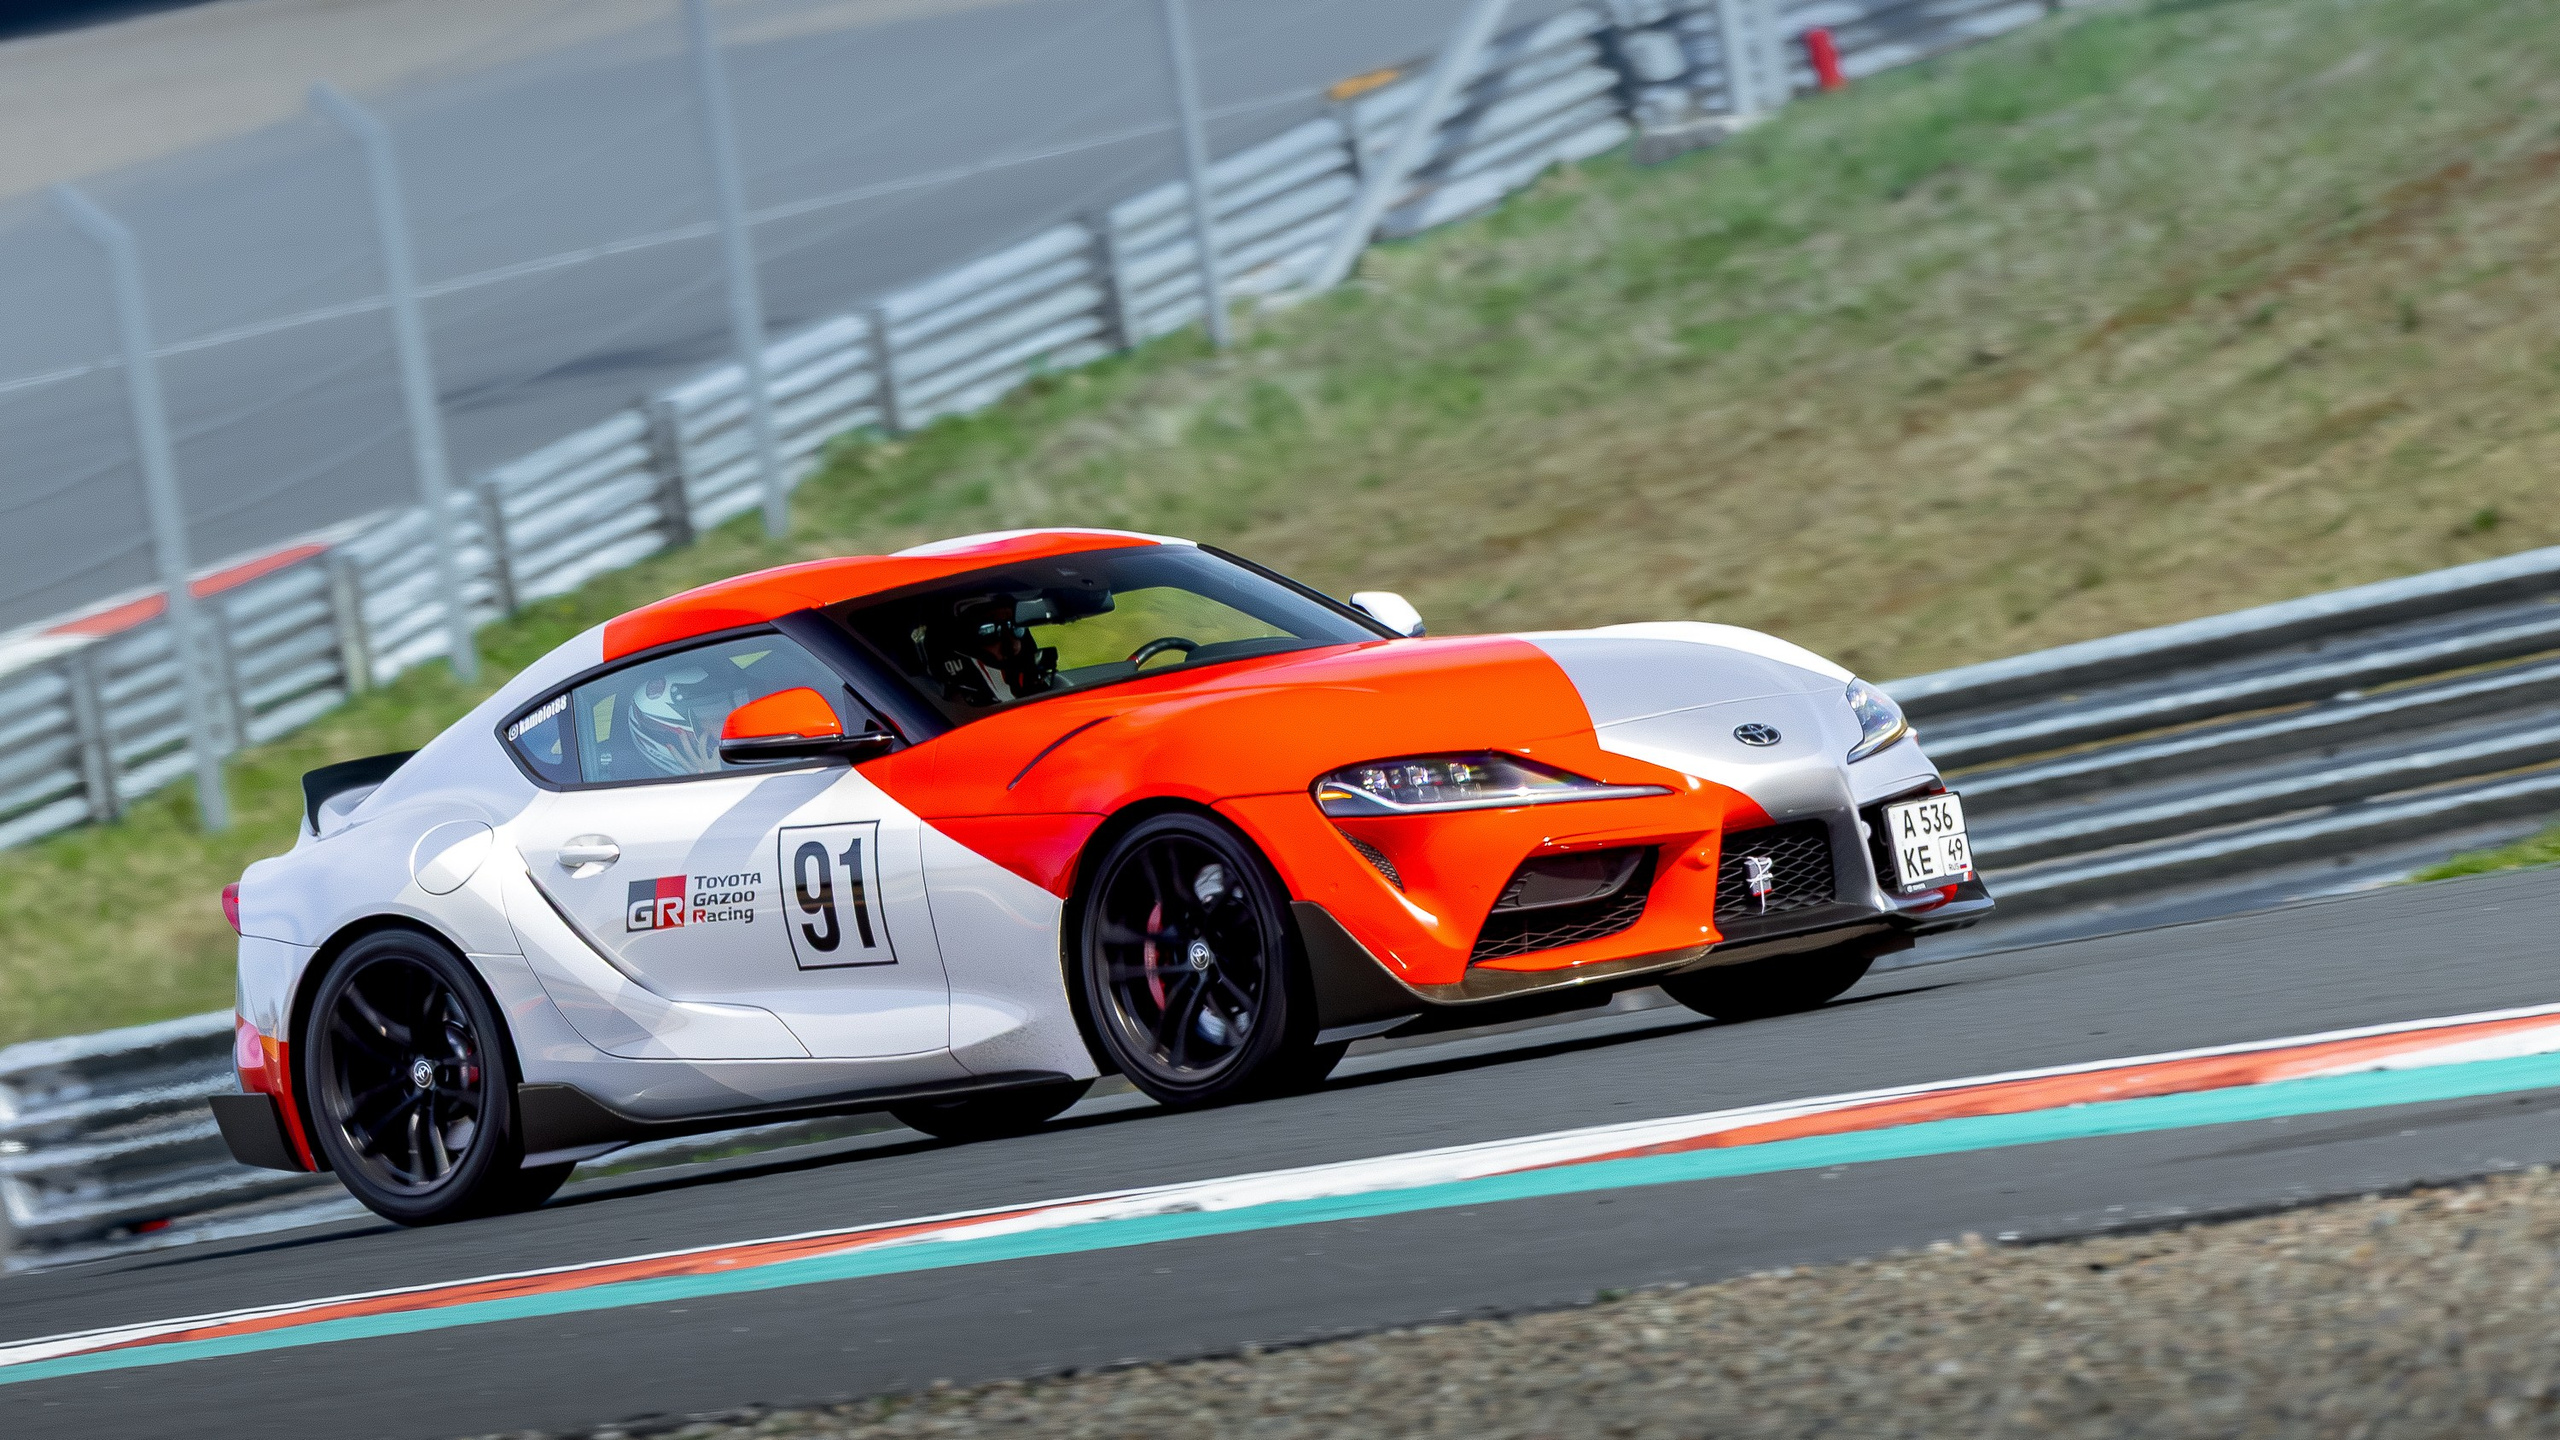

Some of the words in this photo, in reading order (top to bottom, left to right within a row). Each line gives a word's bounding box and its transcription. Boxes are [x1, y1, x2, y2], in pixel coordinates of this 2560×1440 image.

[1903, 809, 1917, 839] A
[1919, 802, 1953, 835] 536
[1903, 845, 1934, 879] KE
[1948, 838, 1963, 861] 49
[694, 872, 762, 890] TOYOTA
[793, 837, 877, 953] 91
[693, 890, 755, 907] GAZOO
[627, 896, 684, 930] GR
[692, 906, 754, 924] Racing
